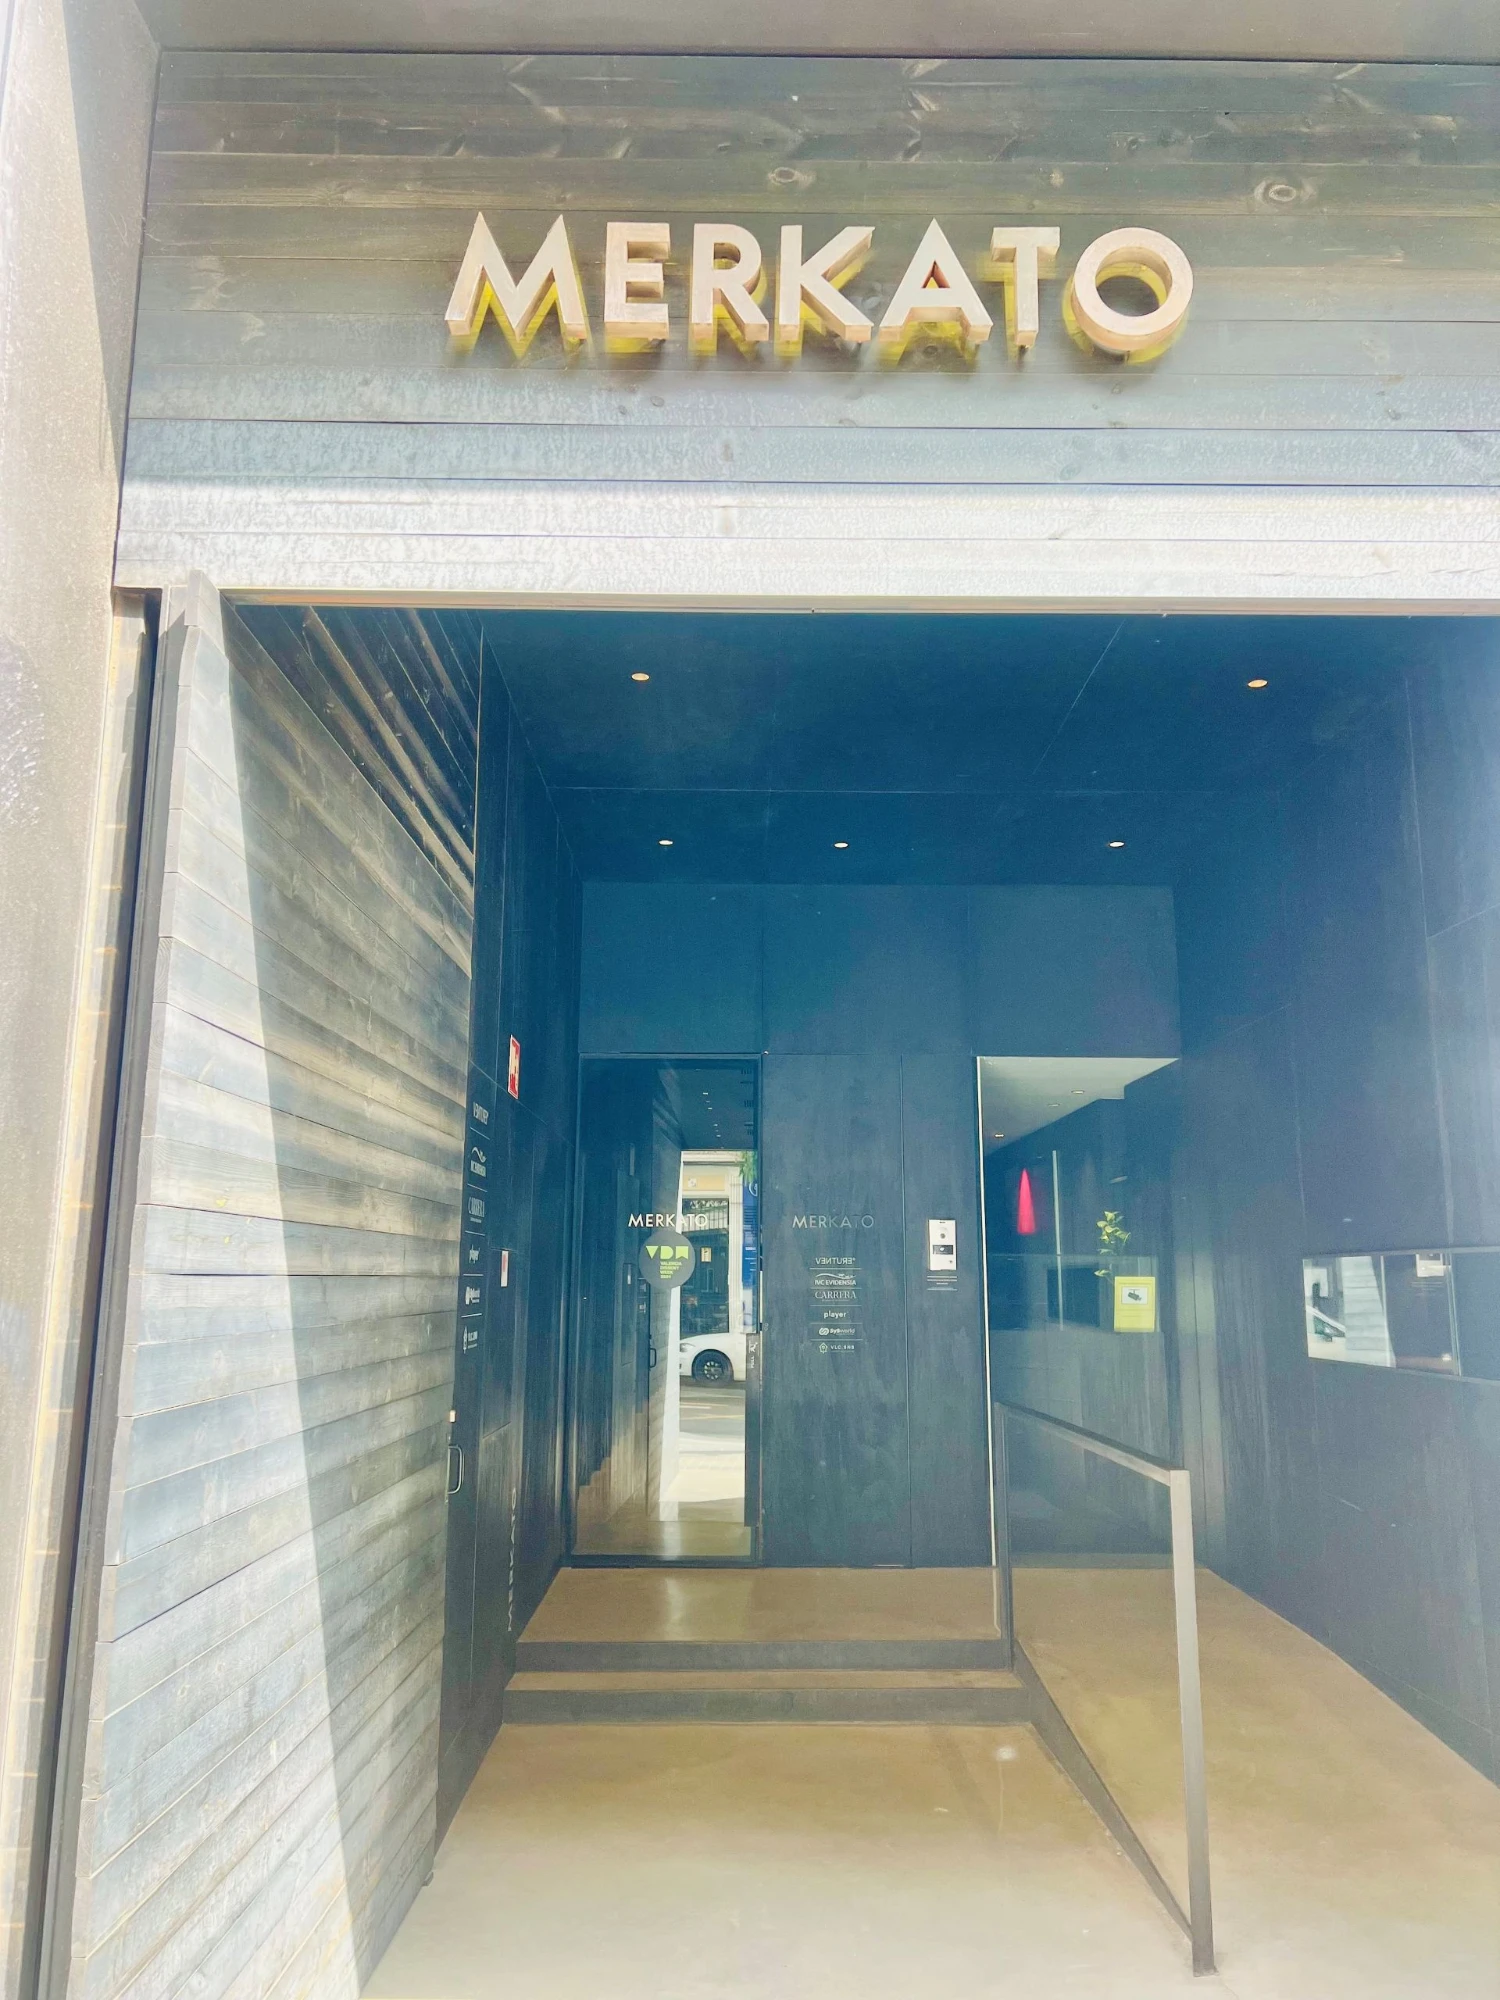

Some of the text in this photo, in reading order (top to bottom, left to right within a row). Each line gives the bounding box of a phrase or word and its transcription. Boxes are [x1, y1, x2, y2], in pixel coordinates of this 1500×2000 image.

[444, 211, 1195, 352] MERKATO
[628, 1213, 708, 1228] MERKATO
[792, 1214, 874, 1229] MERKATO
